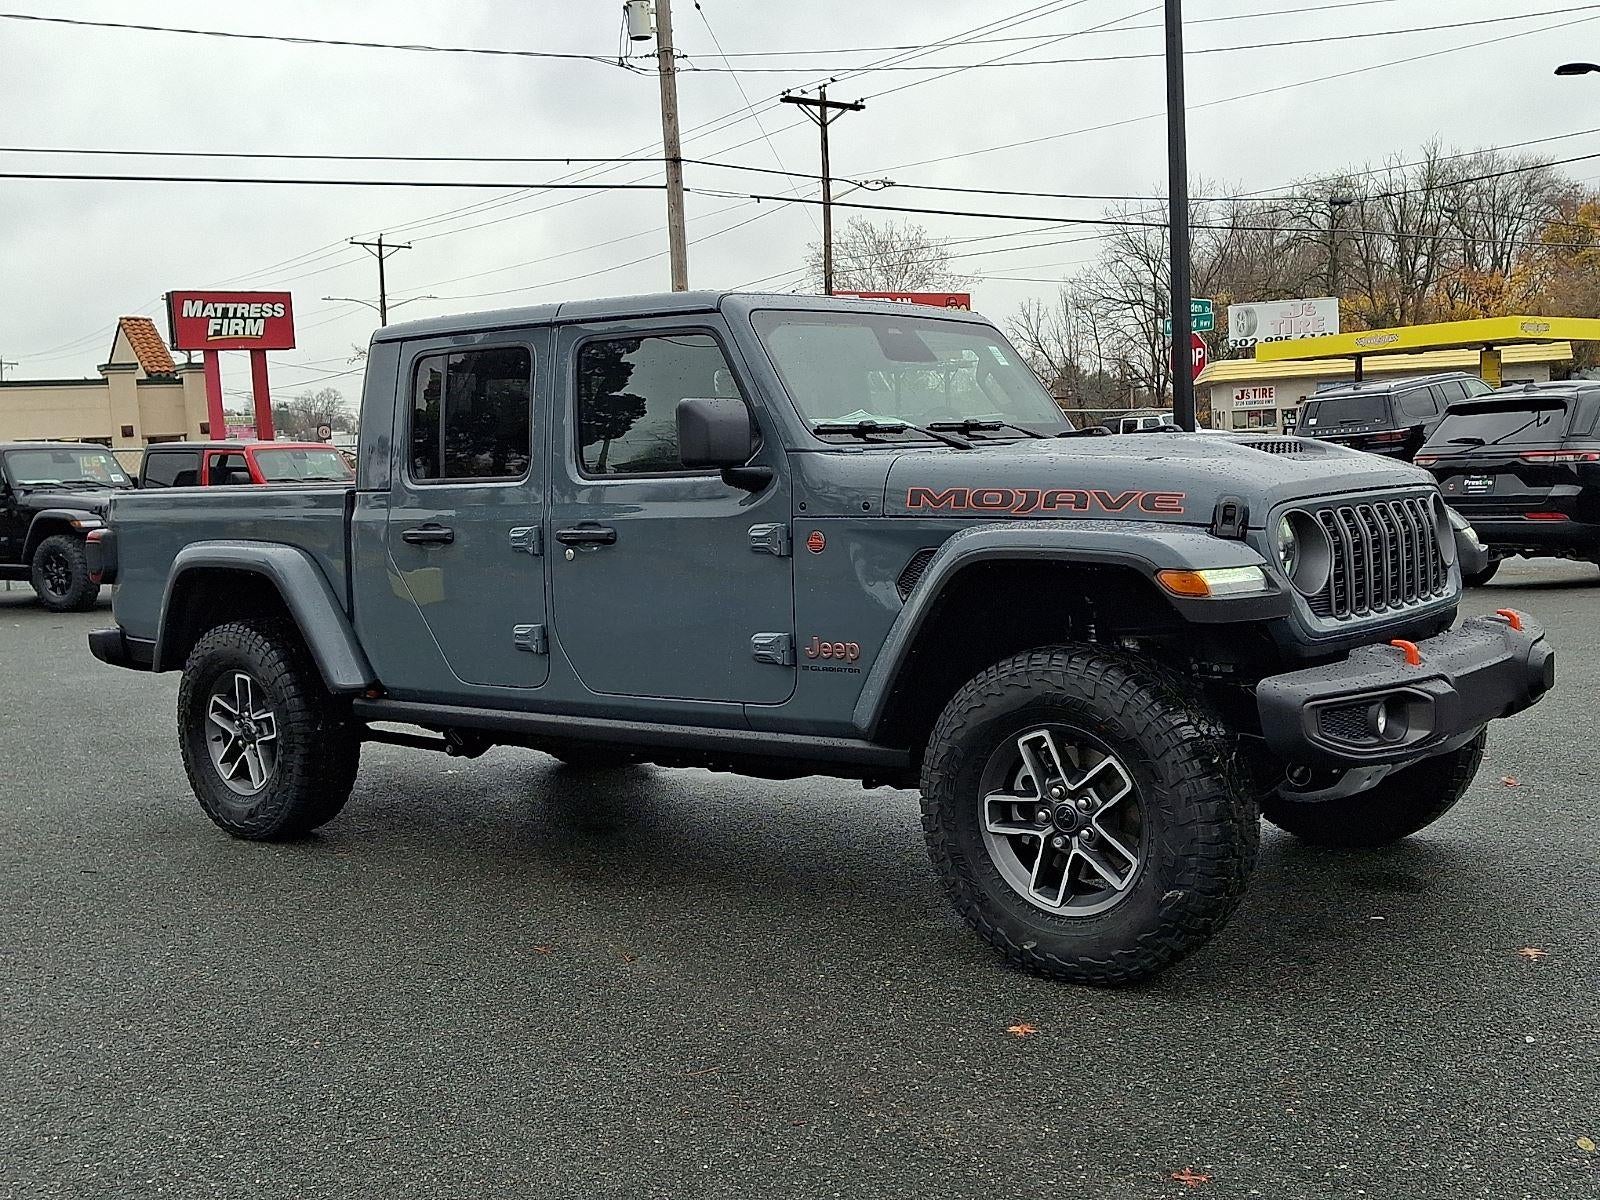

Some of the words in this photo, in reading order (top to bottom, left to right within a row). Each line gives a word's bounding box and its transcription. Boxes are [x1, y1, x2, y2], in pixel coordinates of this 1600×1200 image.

[182, 299, 285, 318] MATTRESS
[208, 318, 265, 336] FIRM
[1269, 317, 1326, 336] TIRE
[1252, 387, 1274, 399] TIRE
[907, 487, 1185, 514] MOJAVE
[804, 635, 860, 664] Jeep
[809, 665, 861, 674] GLADIATOR
